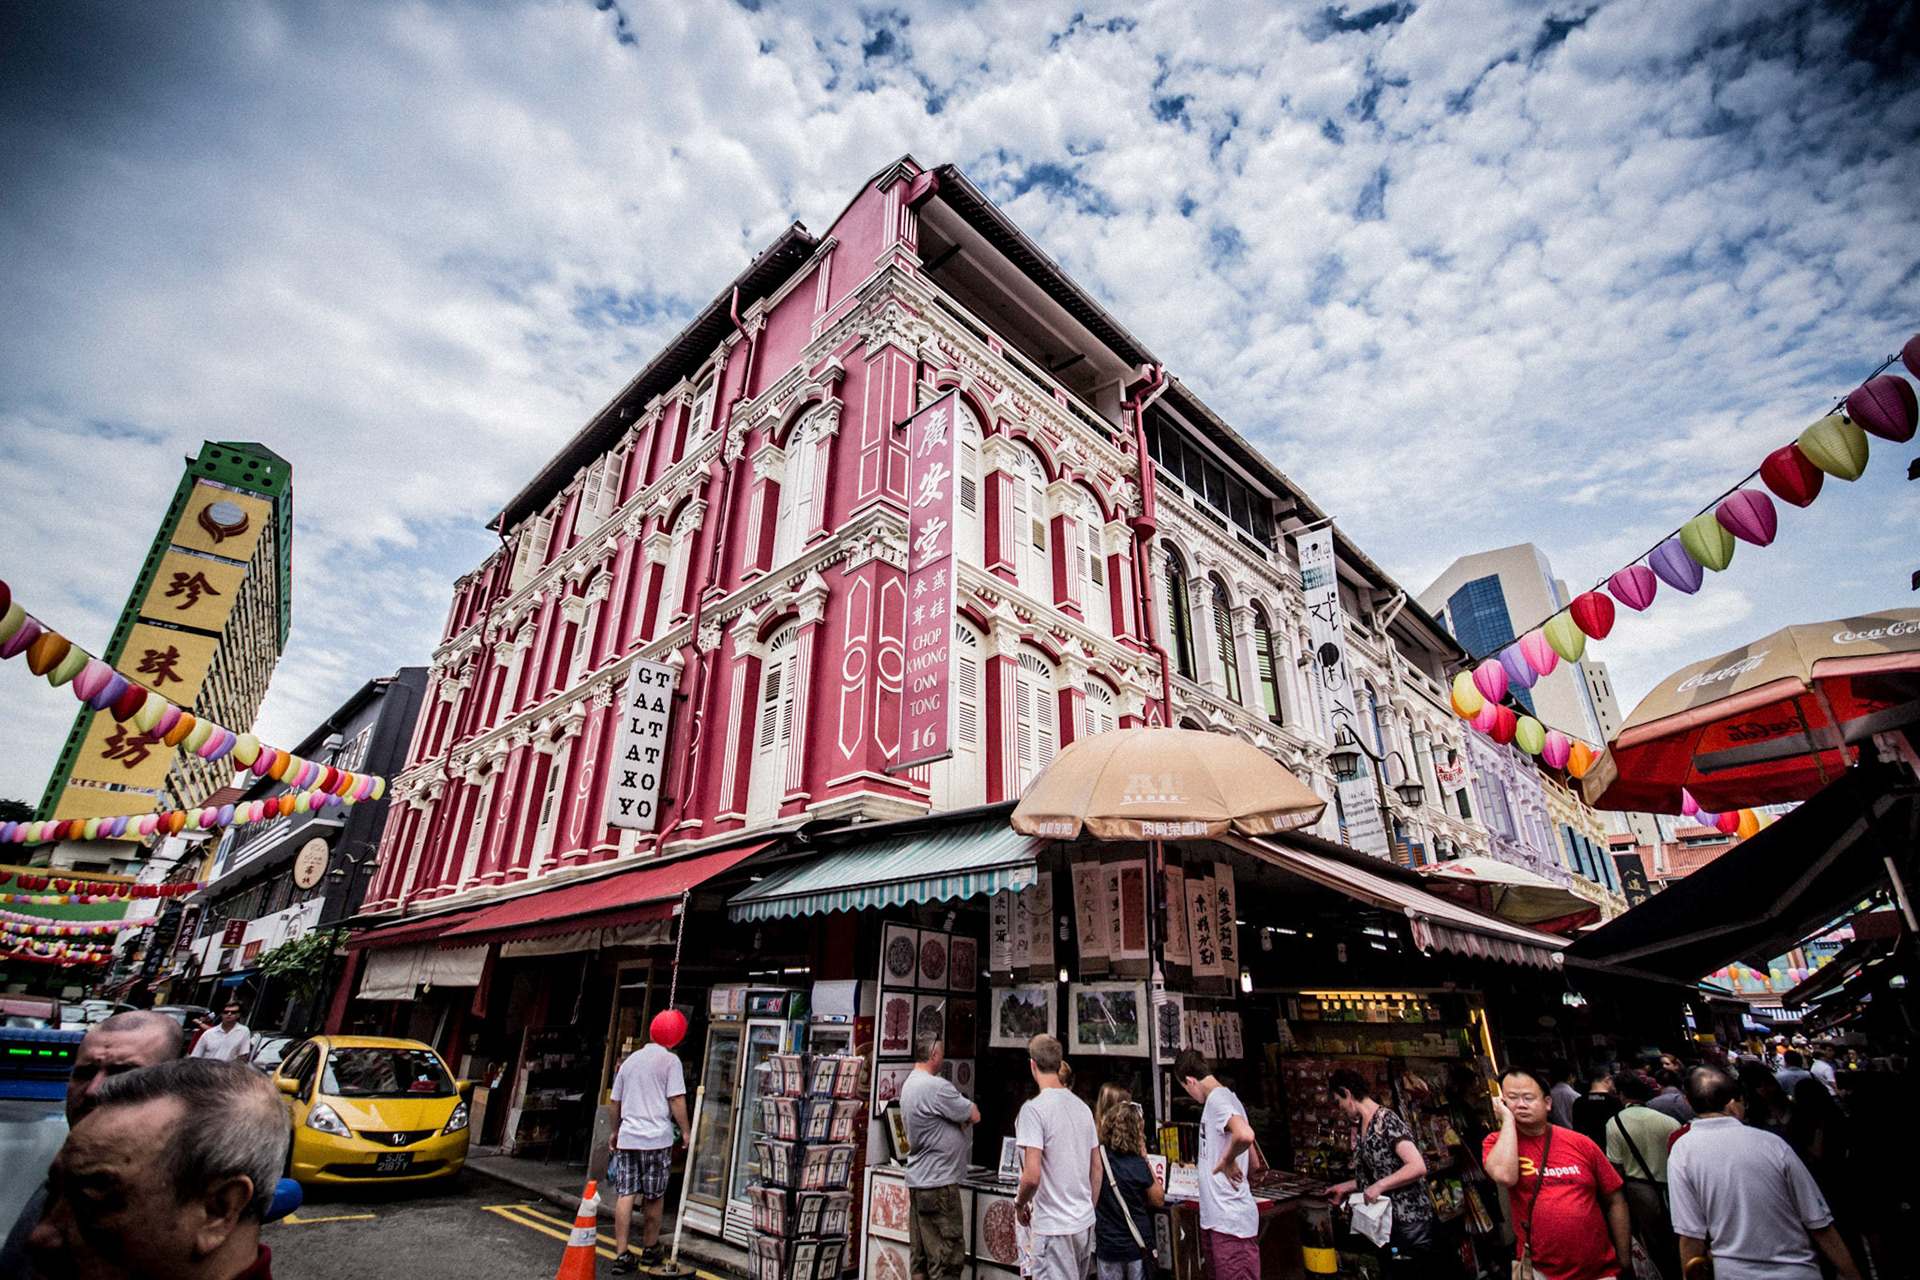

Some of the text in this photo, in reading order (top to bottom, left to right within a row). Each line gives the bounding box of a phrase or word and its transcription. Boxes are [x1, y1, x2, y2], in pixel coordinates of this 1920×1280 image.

[913, 406, 951, 569] 廣安堂
[912, 627, 942, 652] CHOP
[906, 646, 947, 675] KWONG
[913, 671, 938, 694] ONN
[910, 693, 940, 717] TONG
[909, 722, 937, 752] 16
[376, 1161, 408, 1171] 2187Y
[385, 1153, 405, 1162] SJC
